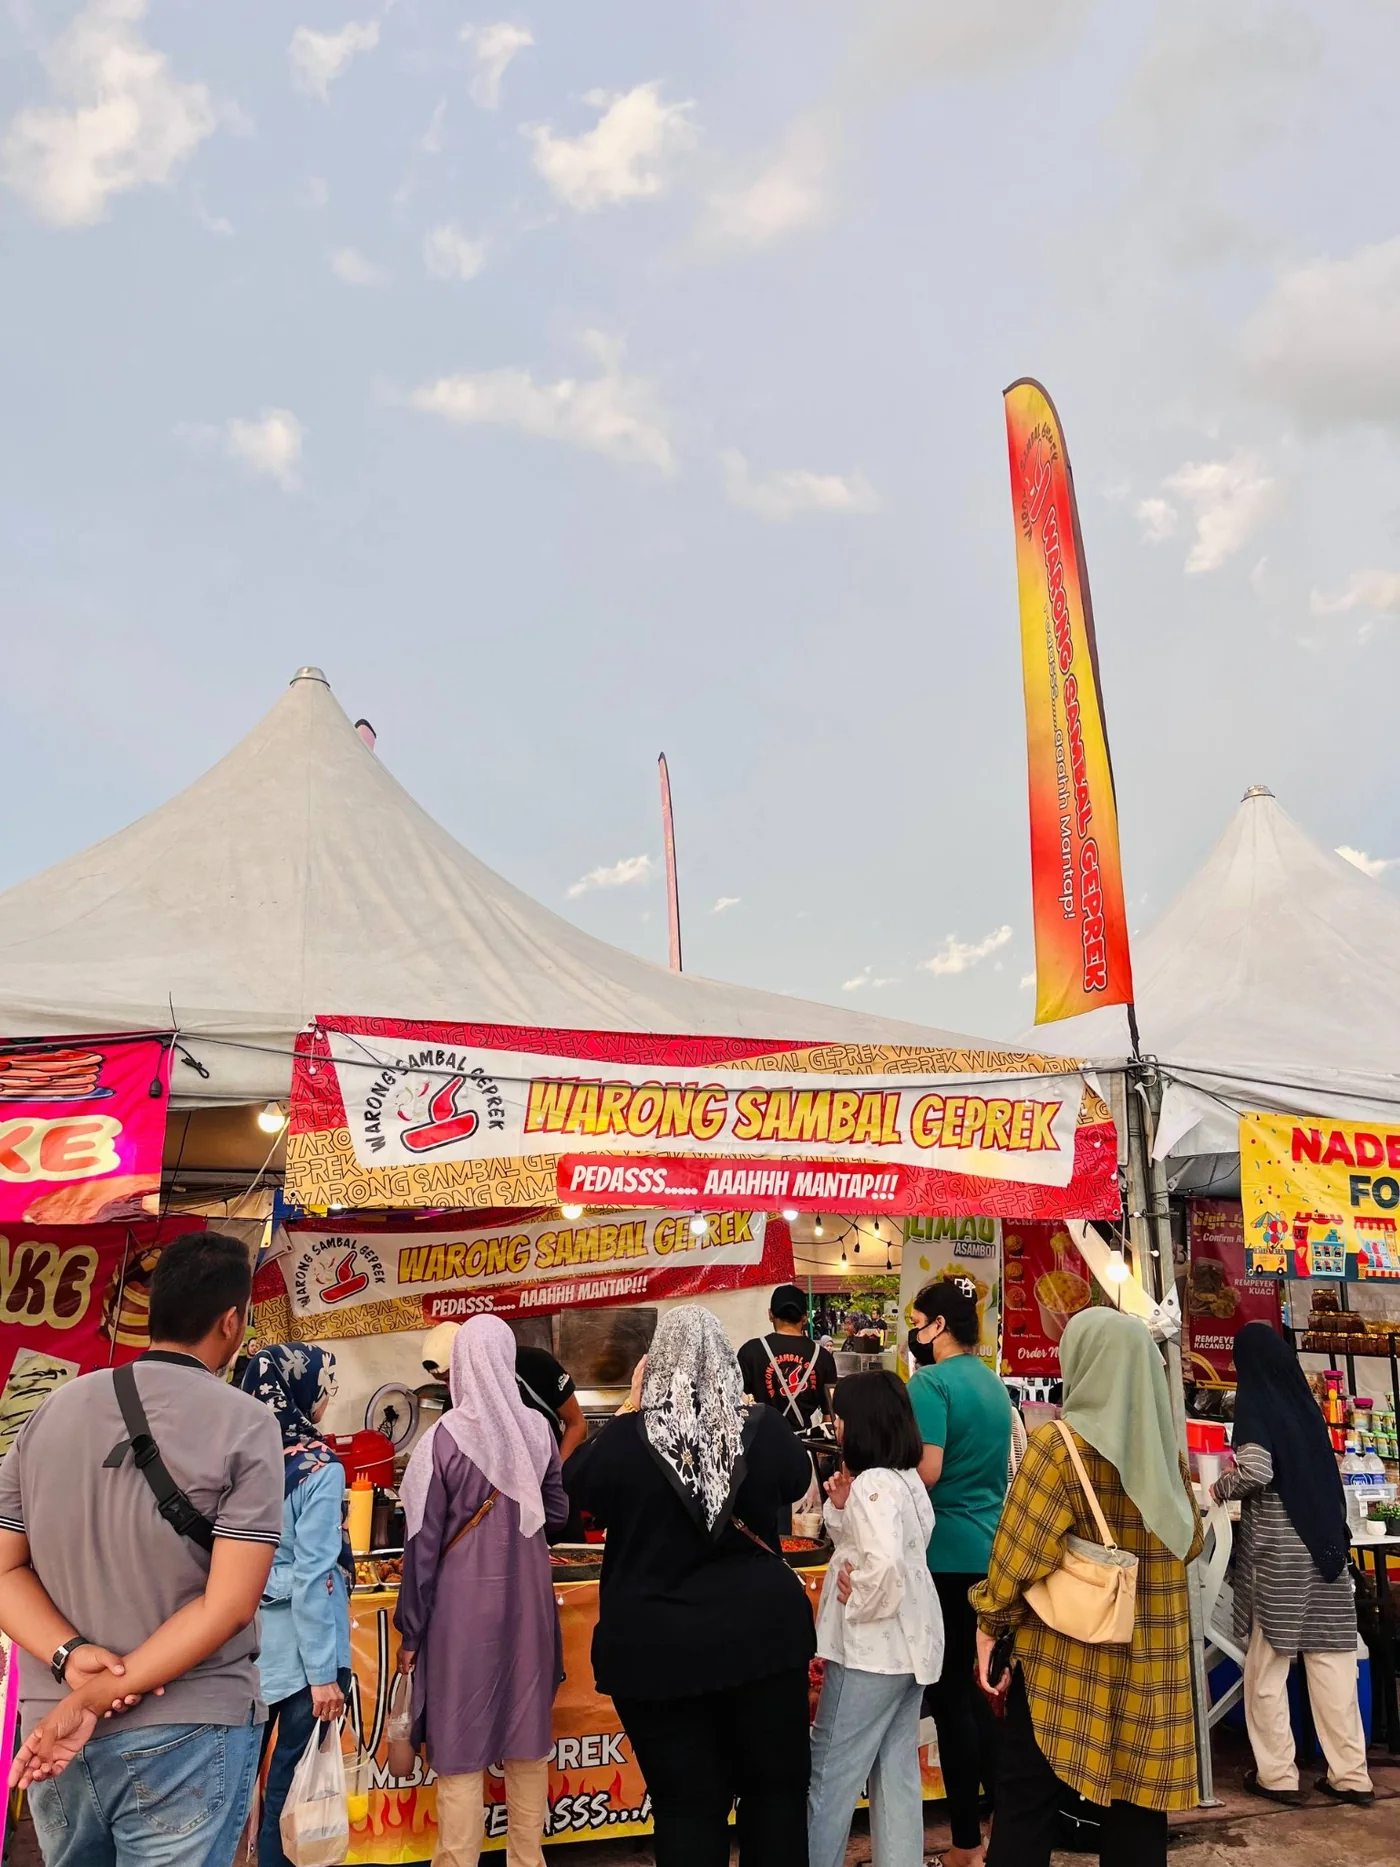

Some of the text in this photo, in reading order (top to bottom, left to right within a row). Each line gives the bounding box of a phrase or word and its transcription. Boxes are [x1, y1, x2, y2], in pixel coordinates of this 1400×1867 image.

[1042, 504, 1108, 993] WARONG SAMBAL GEPREK
[364, 1066, 397, 1153] WARONG
[396, 1050, 467, 1076] SAMBAL
[470, 1067, 505, 1131] GEPREK
[524, 1076, 729, 1141] WARONG
[732, 1086, 903, 1147] SAMBAL
[910, 1093, 1063, 1152] GEPREK
[703, 1169, 790, 1196] AAAHHH
[791, 1170, 899, 1200] MANTAP!!!
[398, 1234, 531, 1284] WARONG
[534, 1220, 648, 1269] SAMBAL
[955, 1244, 996, 1258] ASAMBOI
[1203, 1232, 1235, 1243] Confirm
[312, 1236, 358, 1256] SAMBAL
[360, 1244, 386, 1285] GEPREK
[0, 1235, 98, 1330] KE
[518, 1283, 576, 1308] AAAHHH
[577, 1275, 649, 1302] MANTAP!!!
[1234, 1278, 1275, 1287] REMPEYEK
[1248, 1287, 1275, 1296] KUACI
[1017, 1347, 1048, 1360] Order
[1195, 1334, 1235, 1345] REMPEYE
